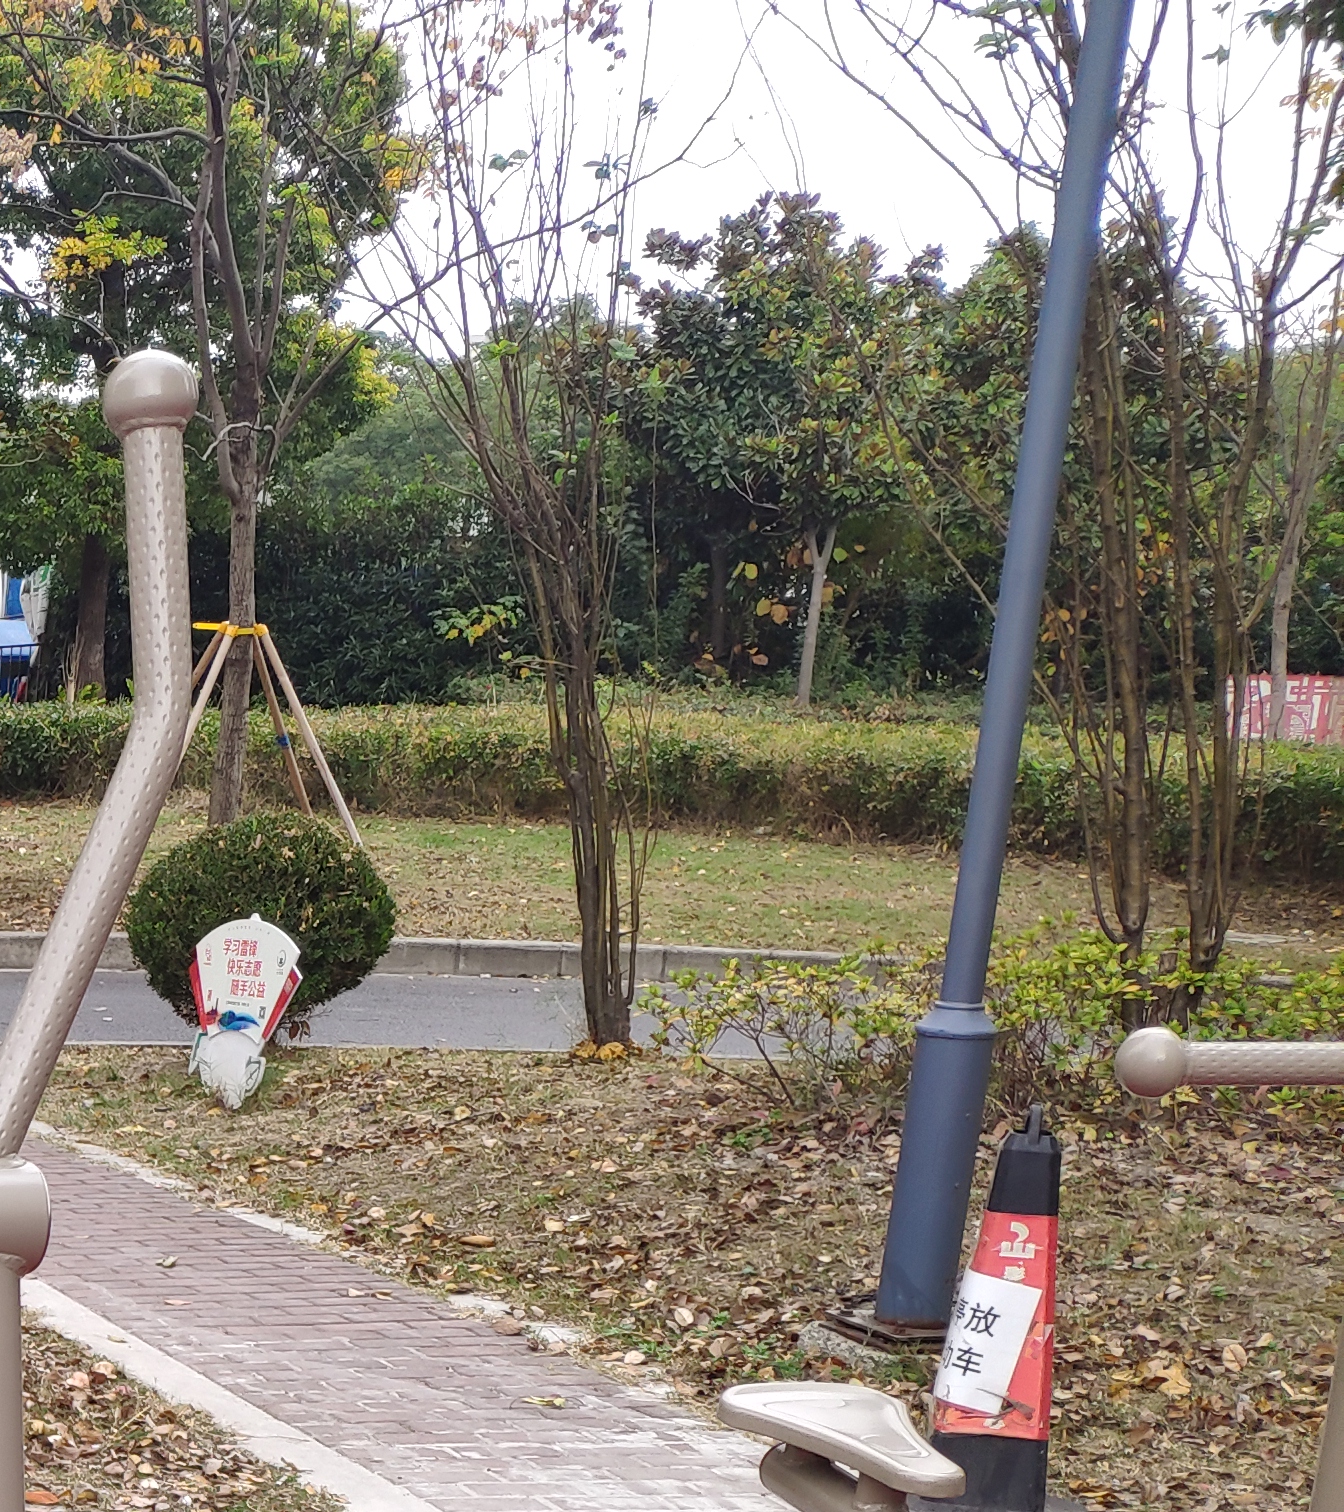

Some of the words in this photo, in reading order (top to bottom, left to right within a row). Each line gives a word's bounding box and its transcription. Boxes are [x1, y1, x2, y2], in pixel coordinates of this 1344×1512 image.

[223, 938, 258, 958] 学习雷锋
[226, 958, 263, 977] 快乐志愿
[229, 978, 266, 999] 随手公益
